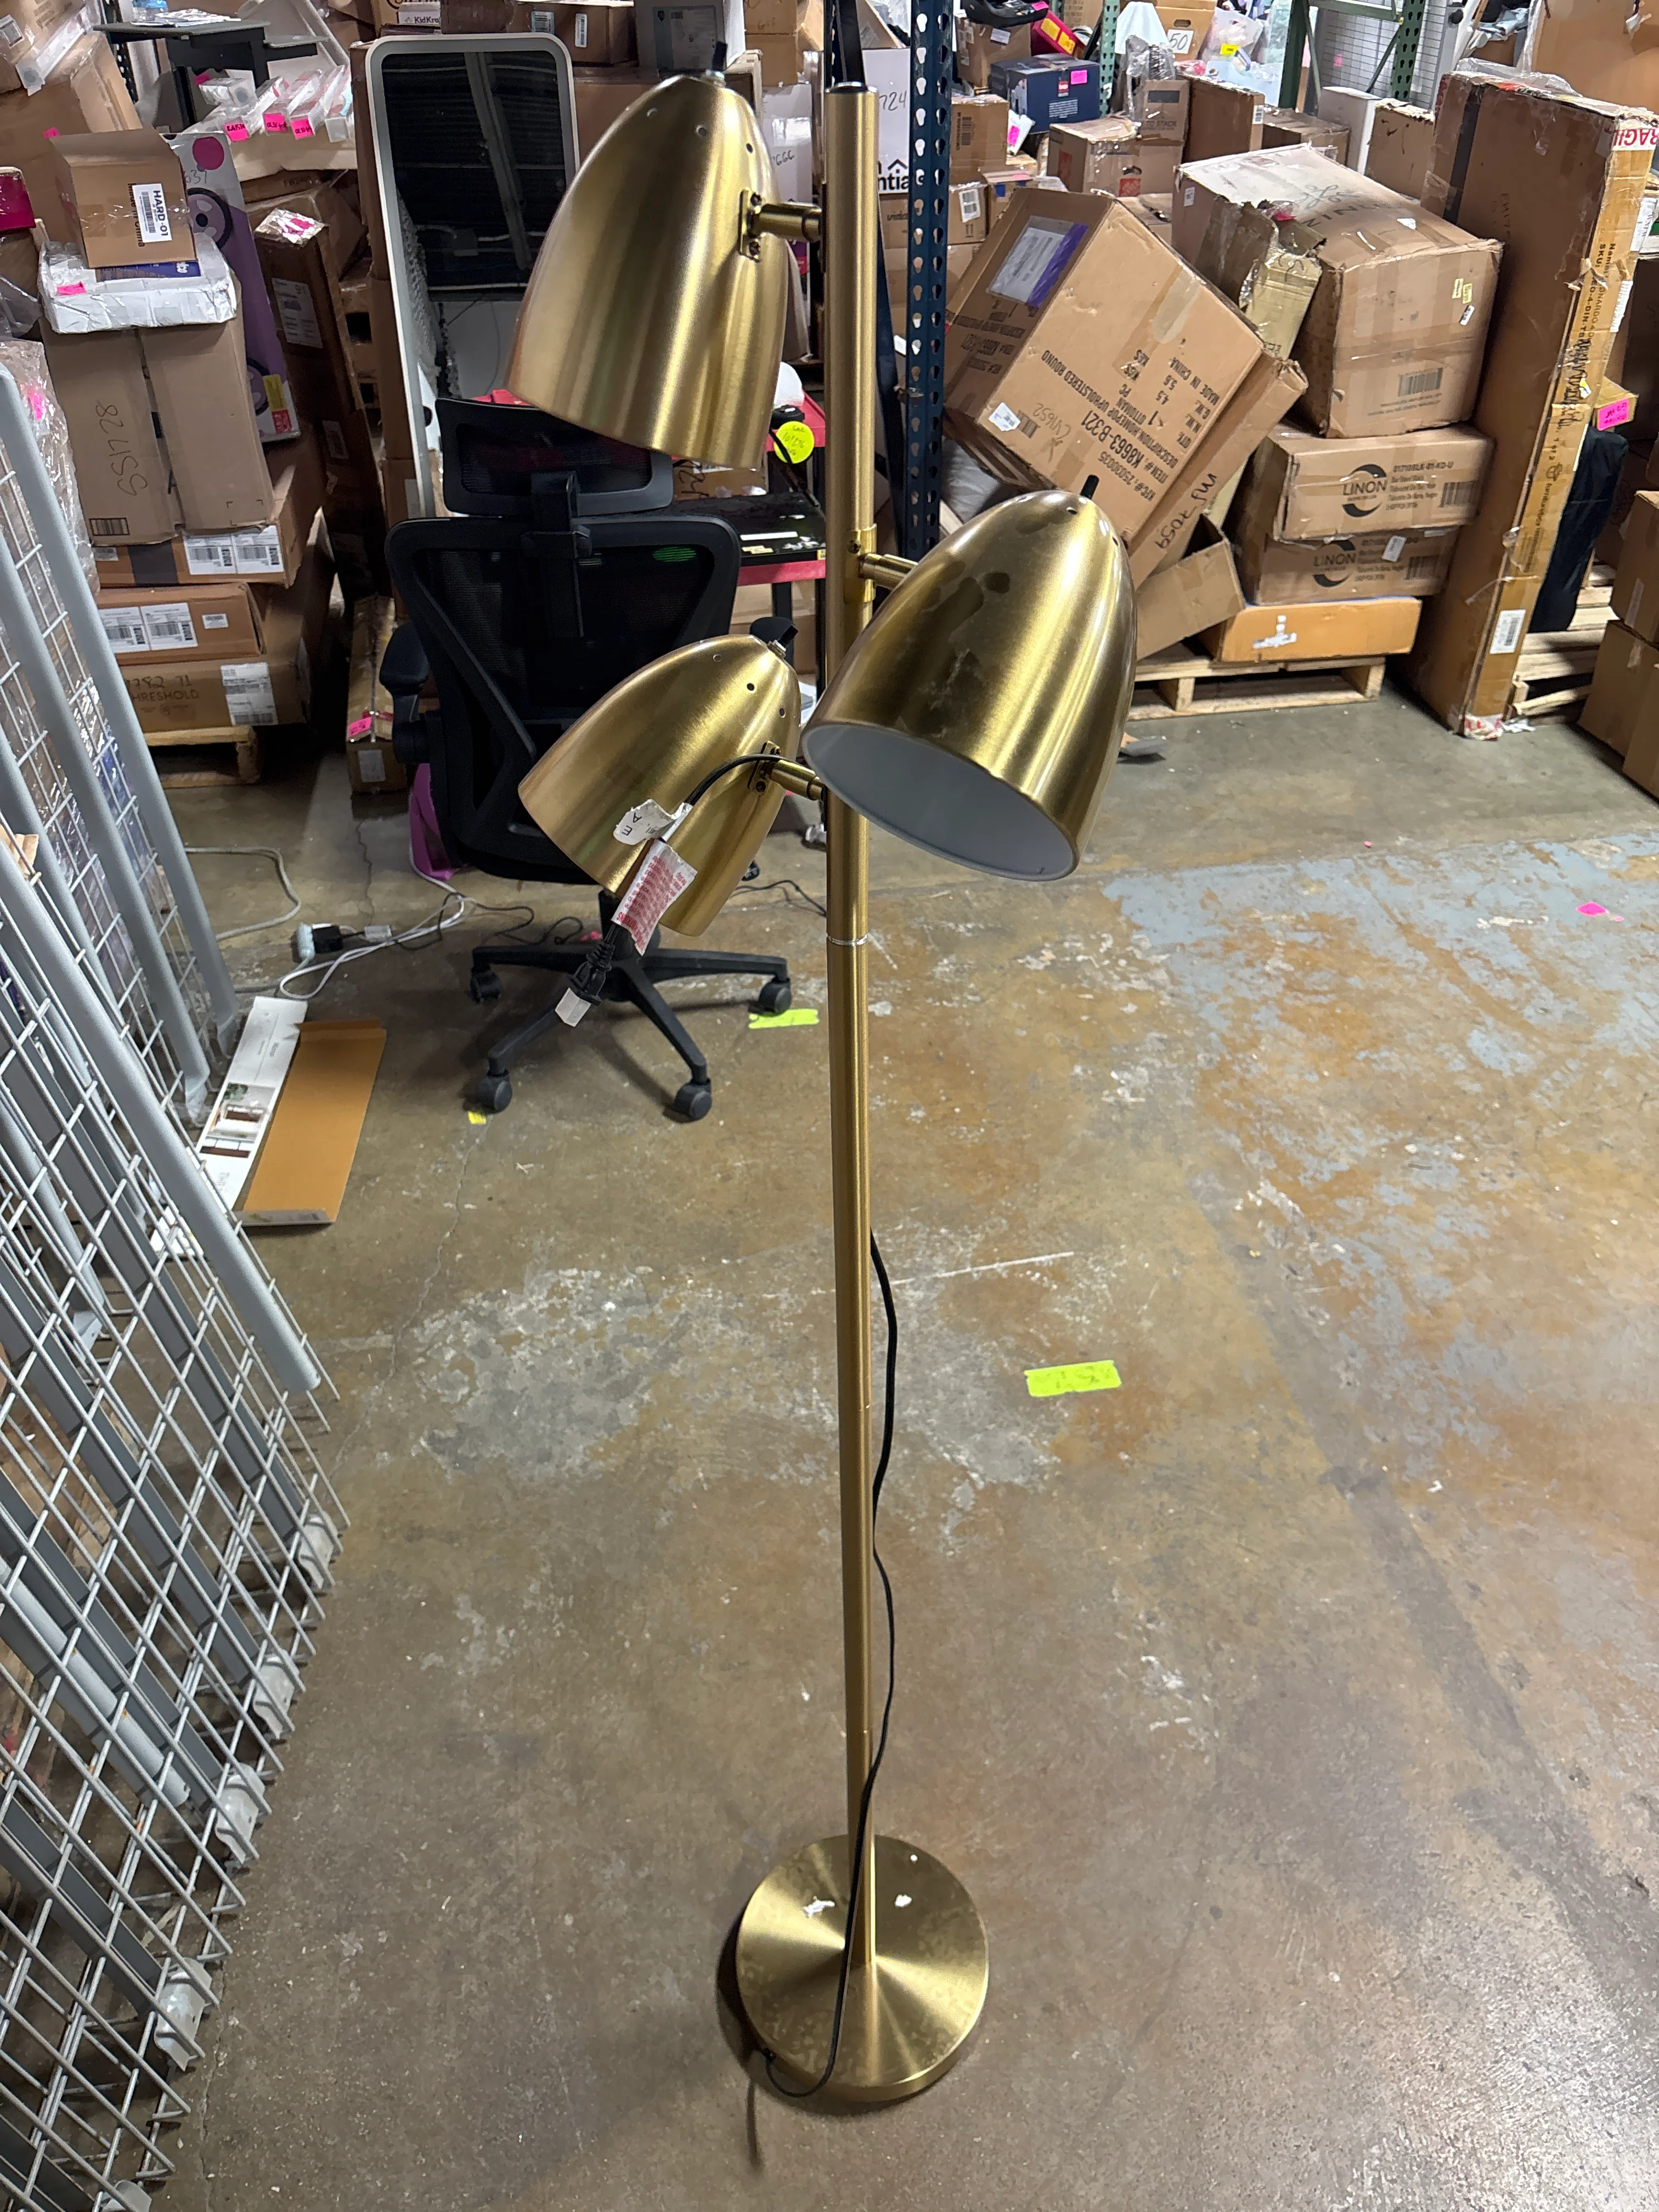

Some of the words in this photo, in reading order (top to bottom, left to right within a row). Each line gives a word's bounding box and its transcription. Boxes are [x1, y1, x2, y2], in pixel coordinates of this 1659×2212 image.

[1170, 33, 1189, 50] 50
[878, 173, 909, 190] ntia
[1039, 349, 1069, 377] ROUND
[1062, 368, 1111, 414] UPHOLSTERED
[1117, 382, 1132, 398] PC
[1154, 389, 1171, 406] 4.5
[1079, 408, 1146, 471] K8663-B321
[1342, 479, 1388, 496] LINON
[1313, 551, 1357, 568] LINON
[131, 689, 199, 702] HRESHOLD
